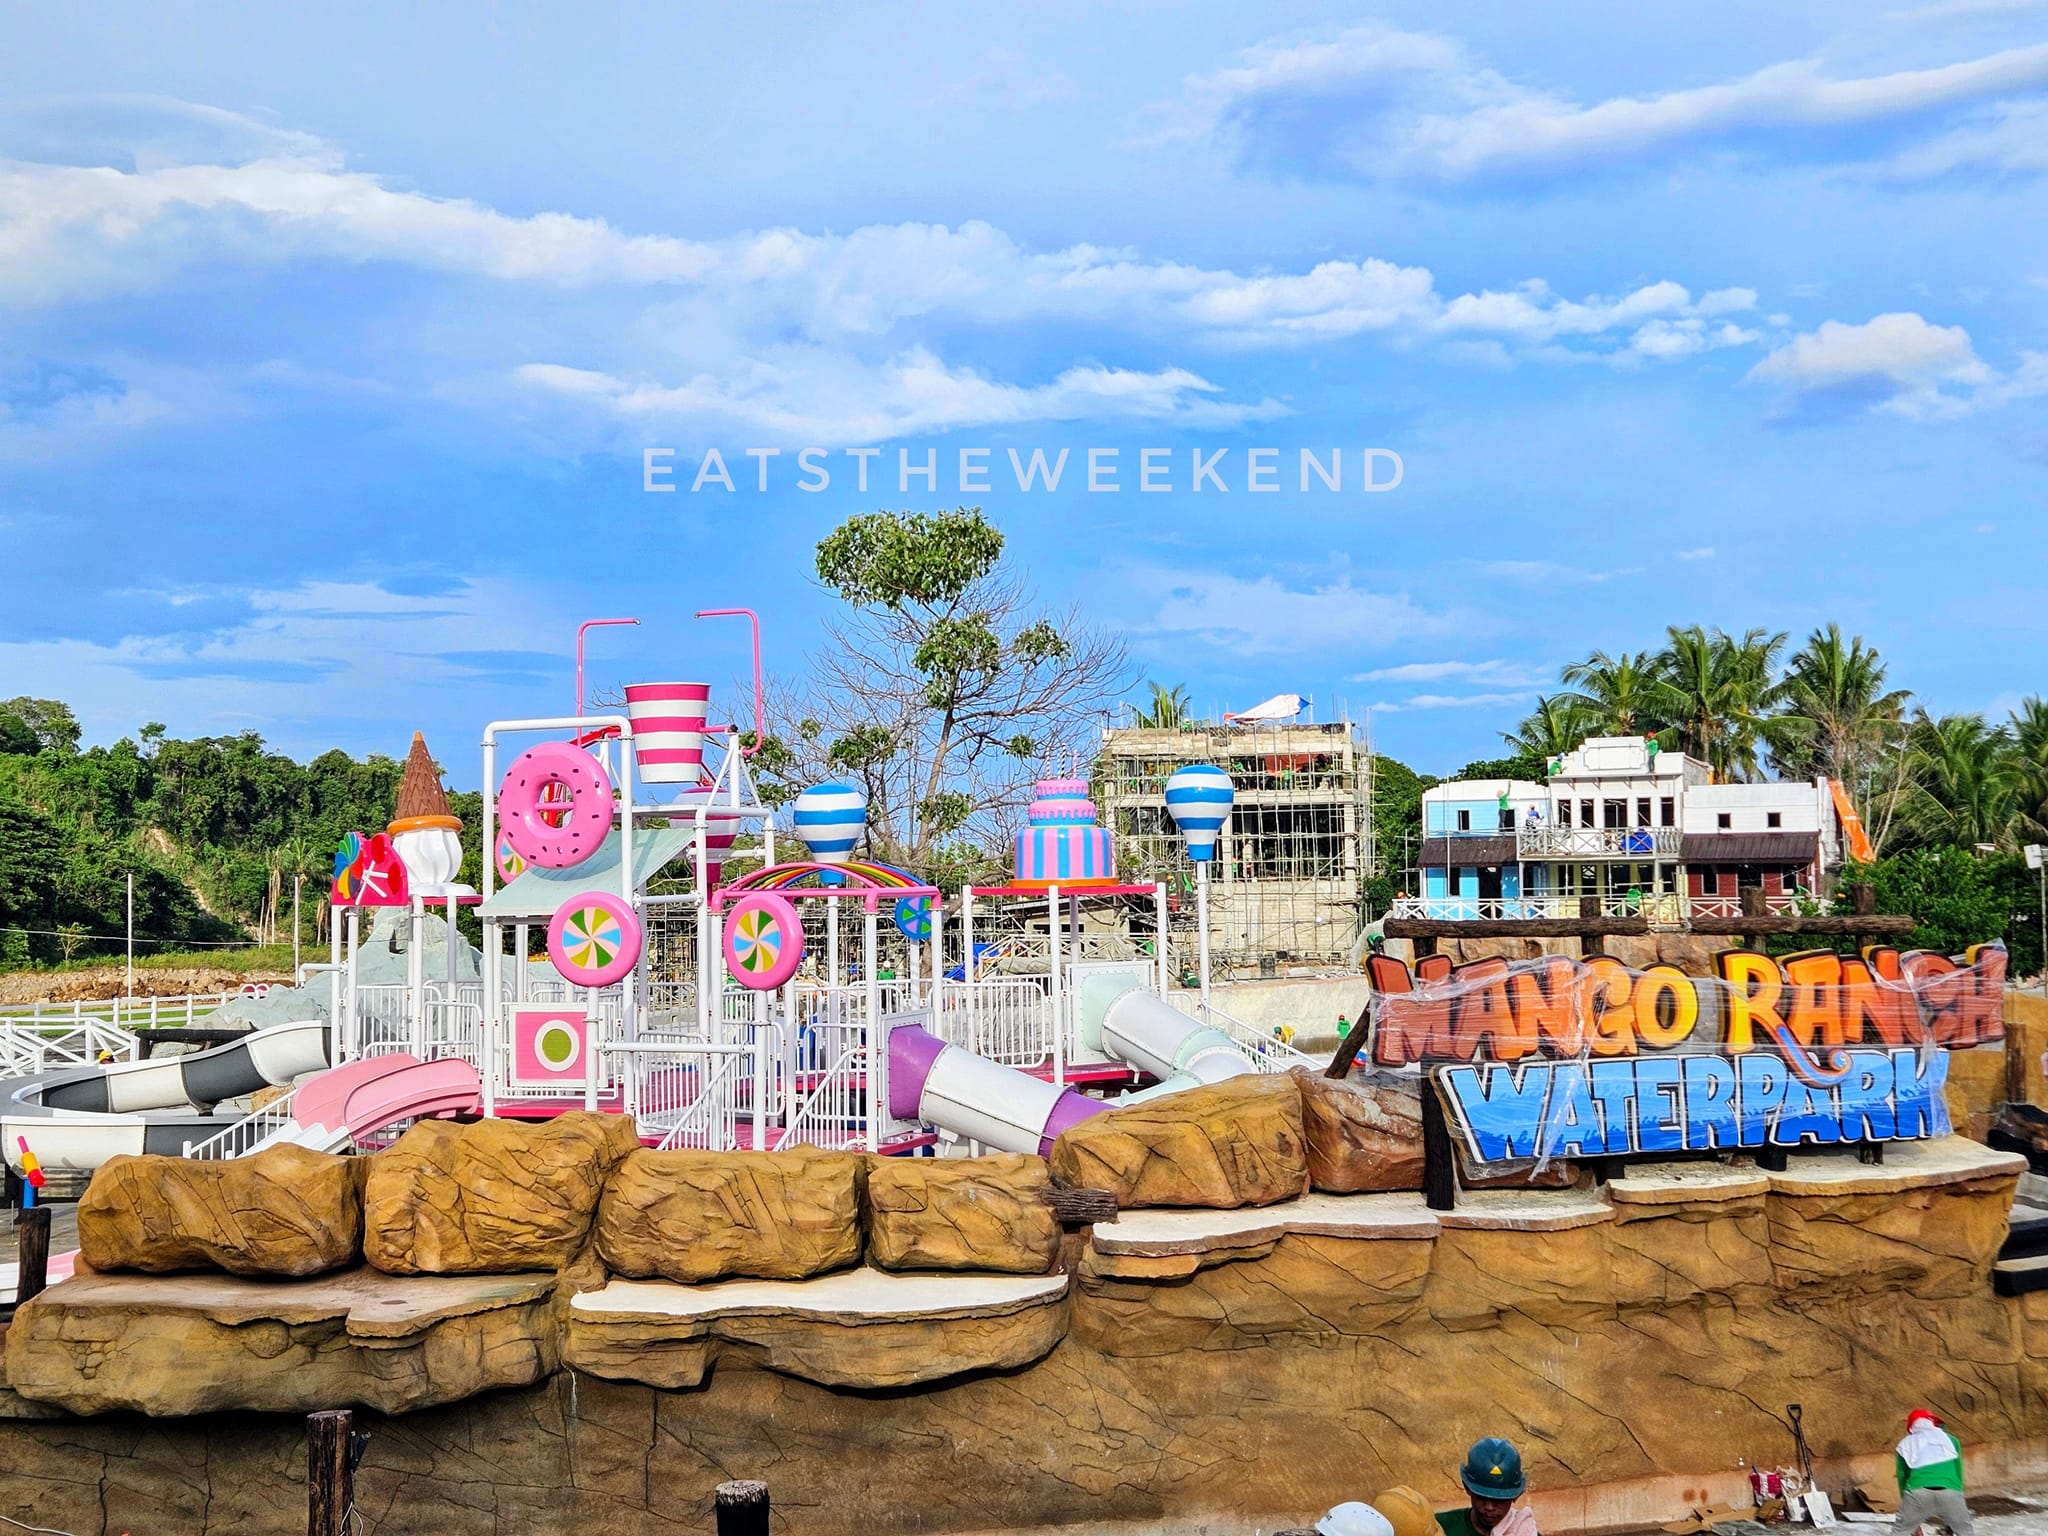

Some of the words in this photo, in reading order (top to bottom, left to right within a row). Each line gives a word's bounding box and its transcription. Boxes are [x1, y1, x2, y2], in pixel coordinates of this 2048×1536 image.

[1366, 954, 1698, 1067] MANGO
[1716, 947, 2008, 1088] RANCH
[1439, 1048, 1950, 1163] WATERPARK
